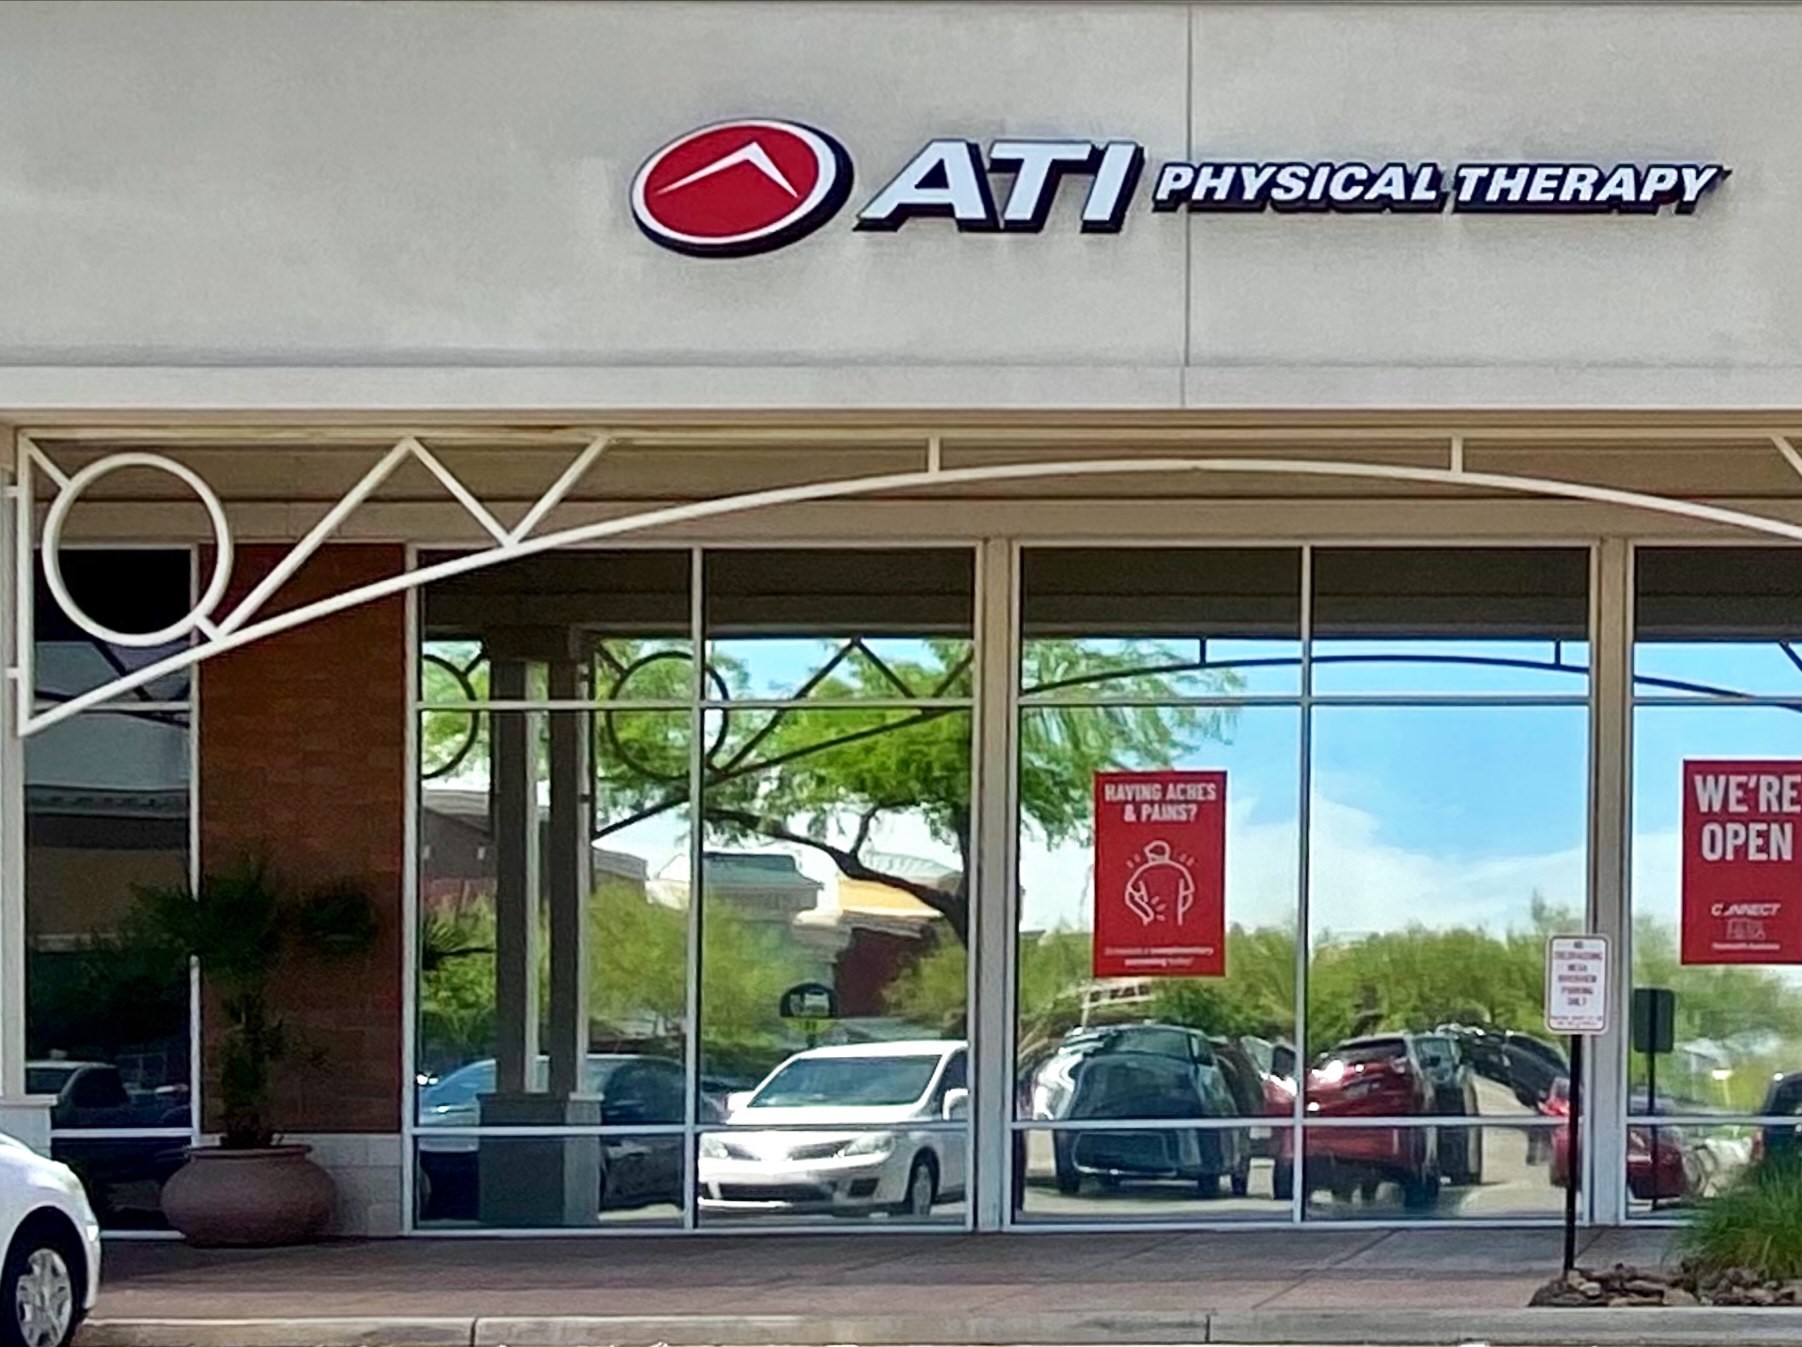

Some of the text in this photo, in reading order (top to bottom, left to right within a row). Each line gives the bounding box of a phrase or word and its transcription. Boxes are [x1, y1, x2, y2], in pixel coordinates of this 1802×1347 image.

[857, 140, 1720, 227] ATI PHYSICAL THERAPY
[1104, 782, 1217, 801] HAVING ACHES
[1694, 774, 1801, 813] WE'RE
[1123, 804, 1198, 822] & PAINS?
[1701, 822, 1792, 861] OPEN
